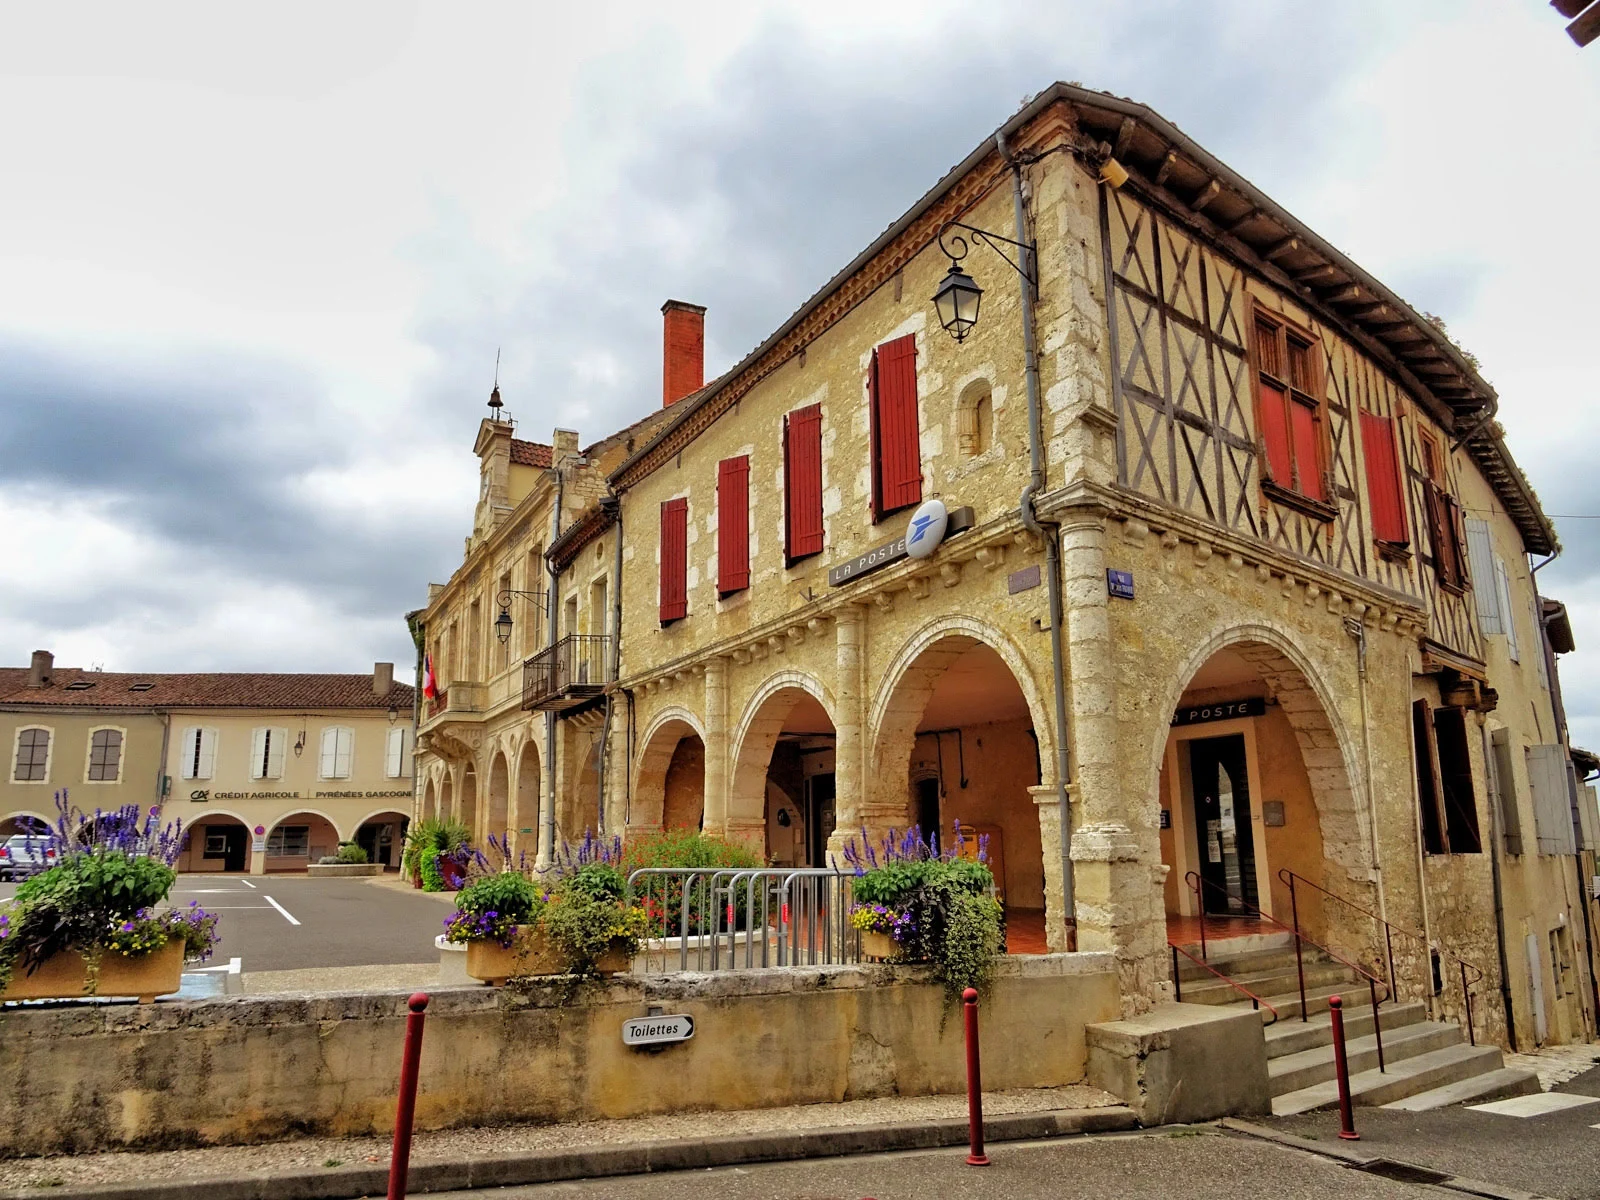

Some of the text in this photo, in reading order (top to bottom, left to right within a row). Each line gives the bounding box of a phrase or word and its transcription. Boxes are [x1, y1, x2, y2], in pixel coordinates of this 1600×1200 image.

[835, 539, 905, 580] LA POSTE
[1189, 703, 1248, 721] POSTE
[214, 791, 250, 799] CRÉDIT
[250, 791, 300, 799] AGRICOLE
[316, 790, 363, 798] PYRÉNÉES
[630, 1024, 679, 1038] Toilettes
